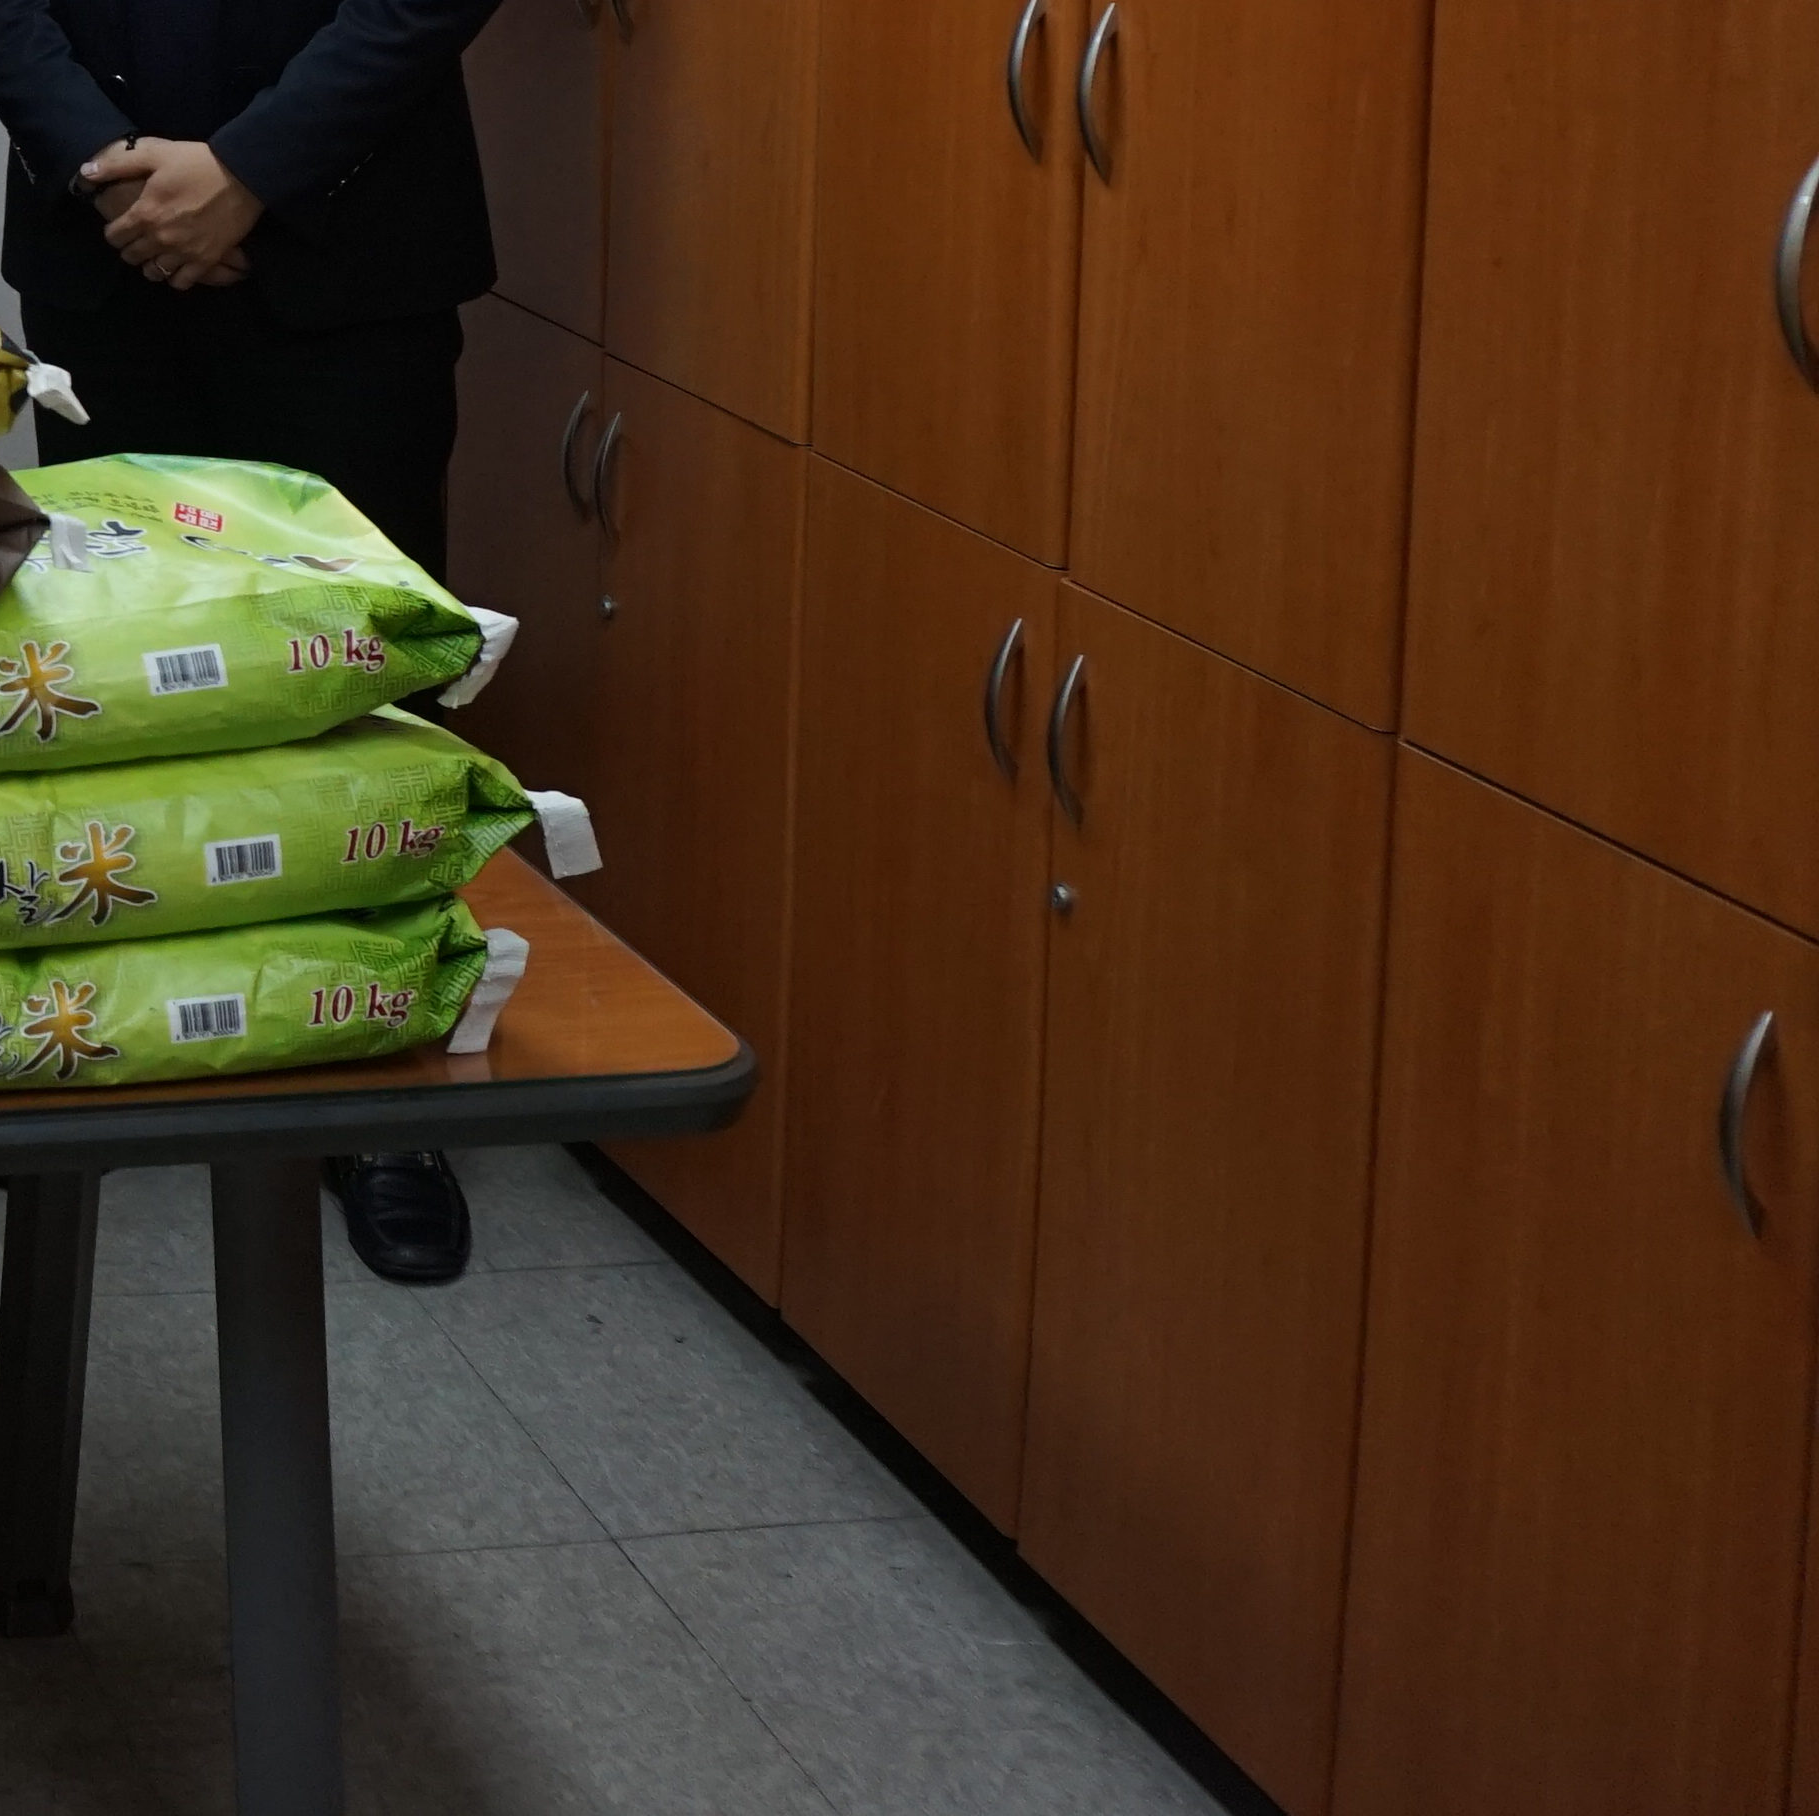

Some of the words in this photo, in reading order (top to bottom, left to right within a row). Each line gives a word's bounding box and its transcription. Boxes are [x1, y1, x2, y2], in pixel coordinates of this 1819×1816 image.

[287, 636, 331, 673] 10
[341, 629, 385, 672] kg
[341, 825, 387, 865] 10
[396, 820, 444, 858] kg
[308, 989, 353, 1026] 10
[363, 986, 412, 1029] kg
